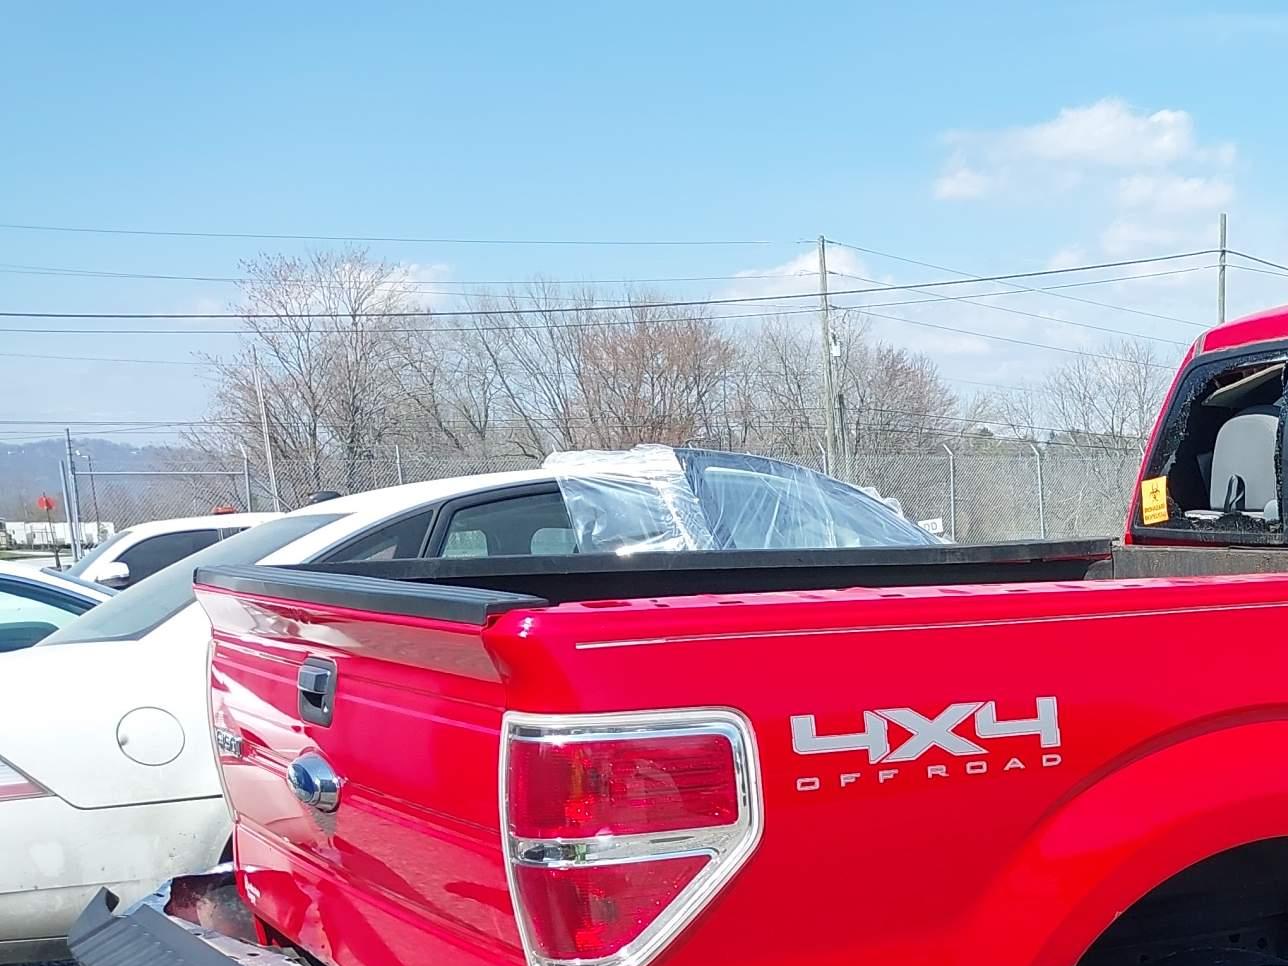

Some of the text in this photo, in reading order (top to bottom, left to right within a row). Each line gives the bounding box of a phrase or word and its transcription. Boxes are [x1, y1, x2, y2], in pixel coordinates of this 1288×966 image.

[789, 695, 1062, 765] 4X4
[795, 753, 1063, 792] OFF ROAD
